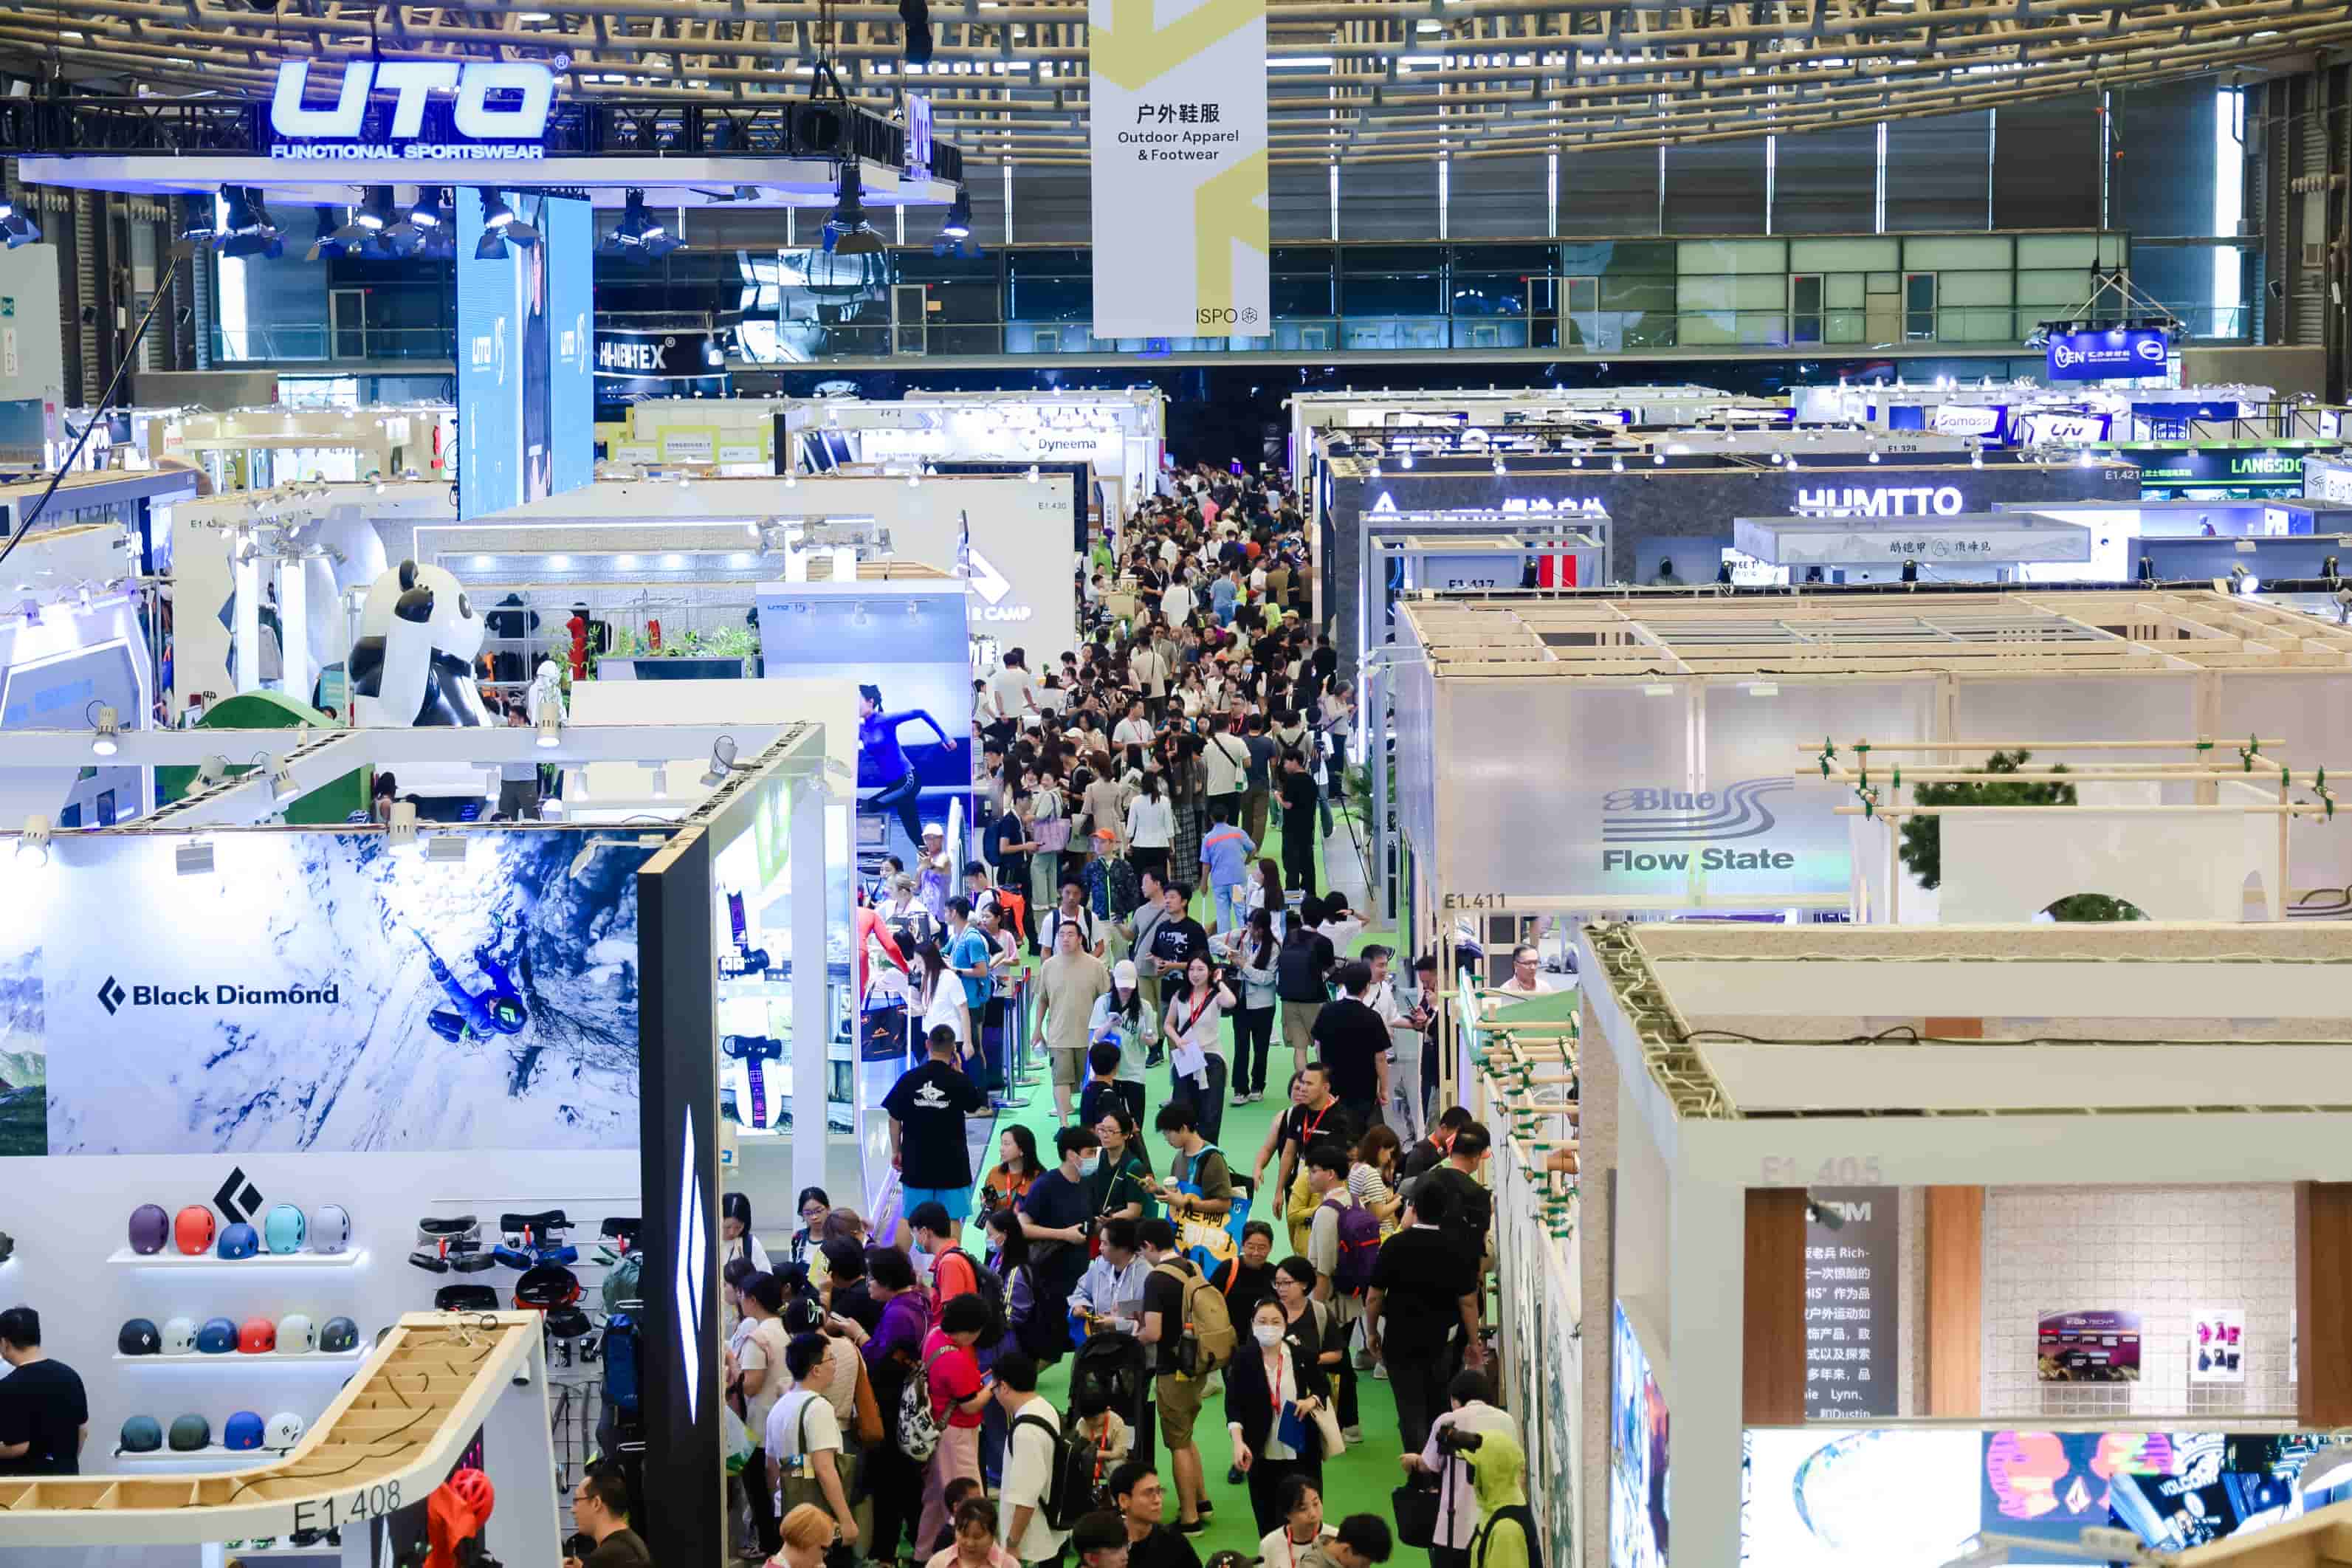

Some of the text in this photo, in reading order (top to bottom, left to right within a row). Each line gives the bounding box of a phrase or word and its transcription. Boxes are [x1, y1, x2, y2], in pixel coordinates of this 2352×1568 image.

[270, 60, 554, 138] UTO
[1137, 103, 1220, 124] 户外鞋服
[1118, 130, 1239, 145] Outdoor Apparel
[272, 145, 544, 159] FUNCTIONAL SPORTSWEAR
[1138, 148, 1219, 160] & Footwear
[1196, 308, 1238, 323] ISPO
[1039, 439, 1096, 452] Dyneema
[1798, 486, 1964, 517] HUMTTO
[1602, 848, 1795, 870] Flow State
[1445, 893, 1506, 909] E1.411
[133, 983, 339, 1005] Black Diamond
[1840, 1247, 1871, 1259] Rich-
[295, 1479, 401, 1532] E1.408
